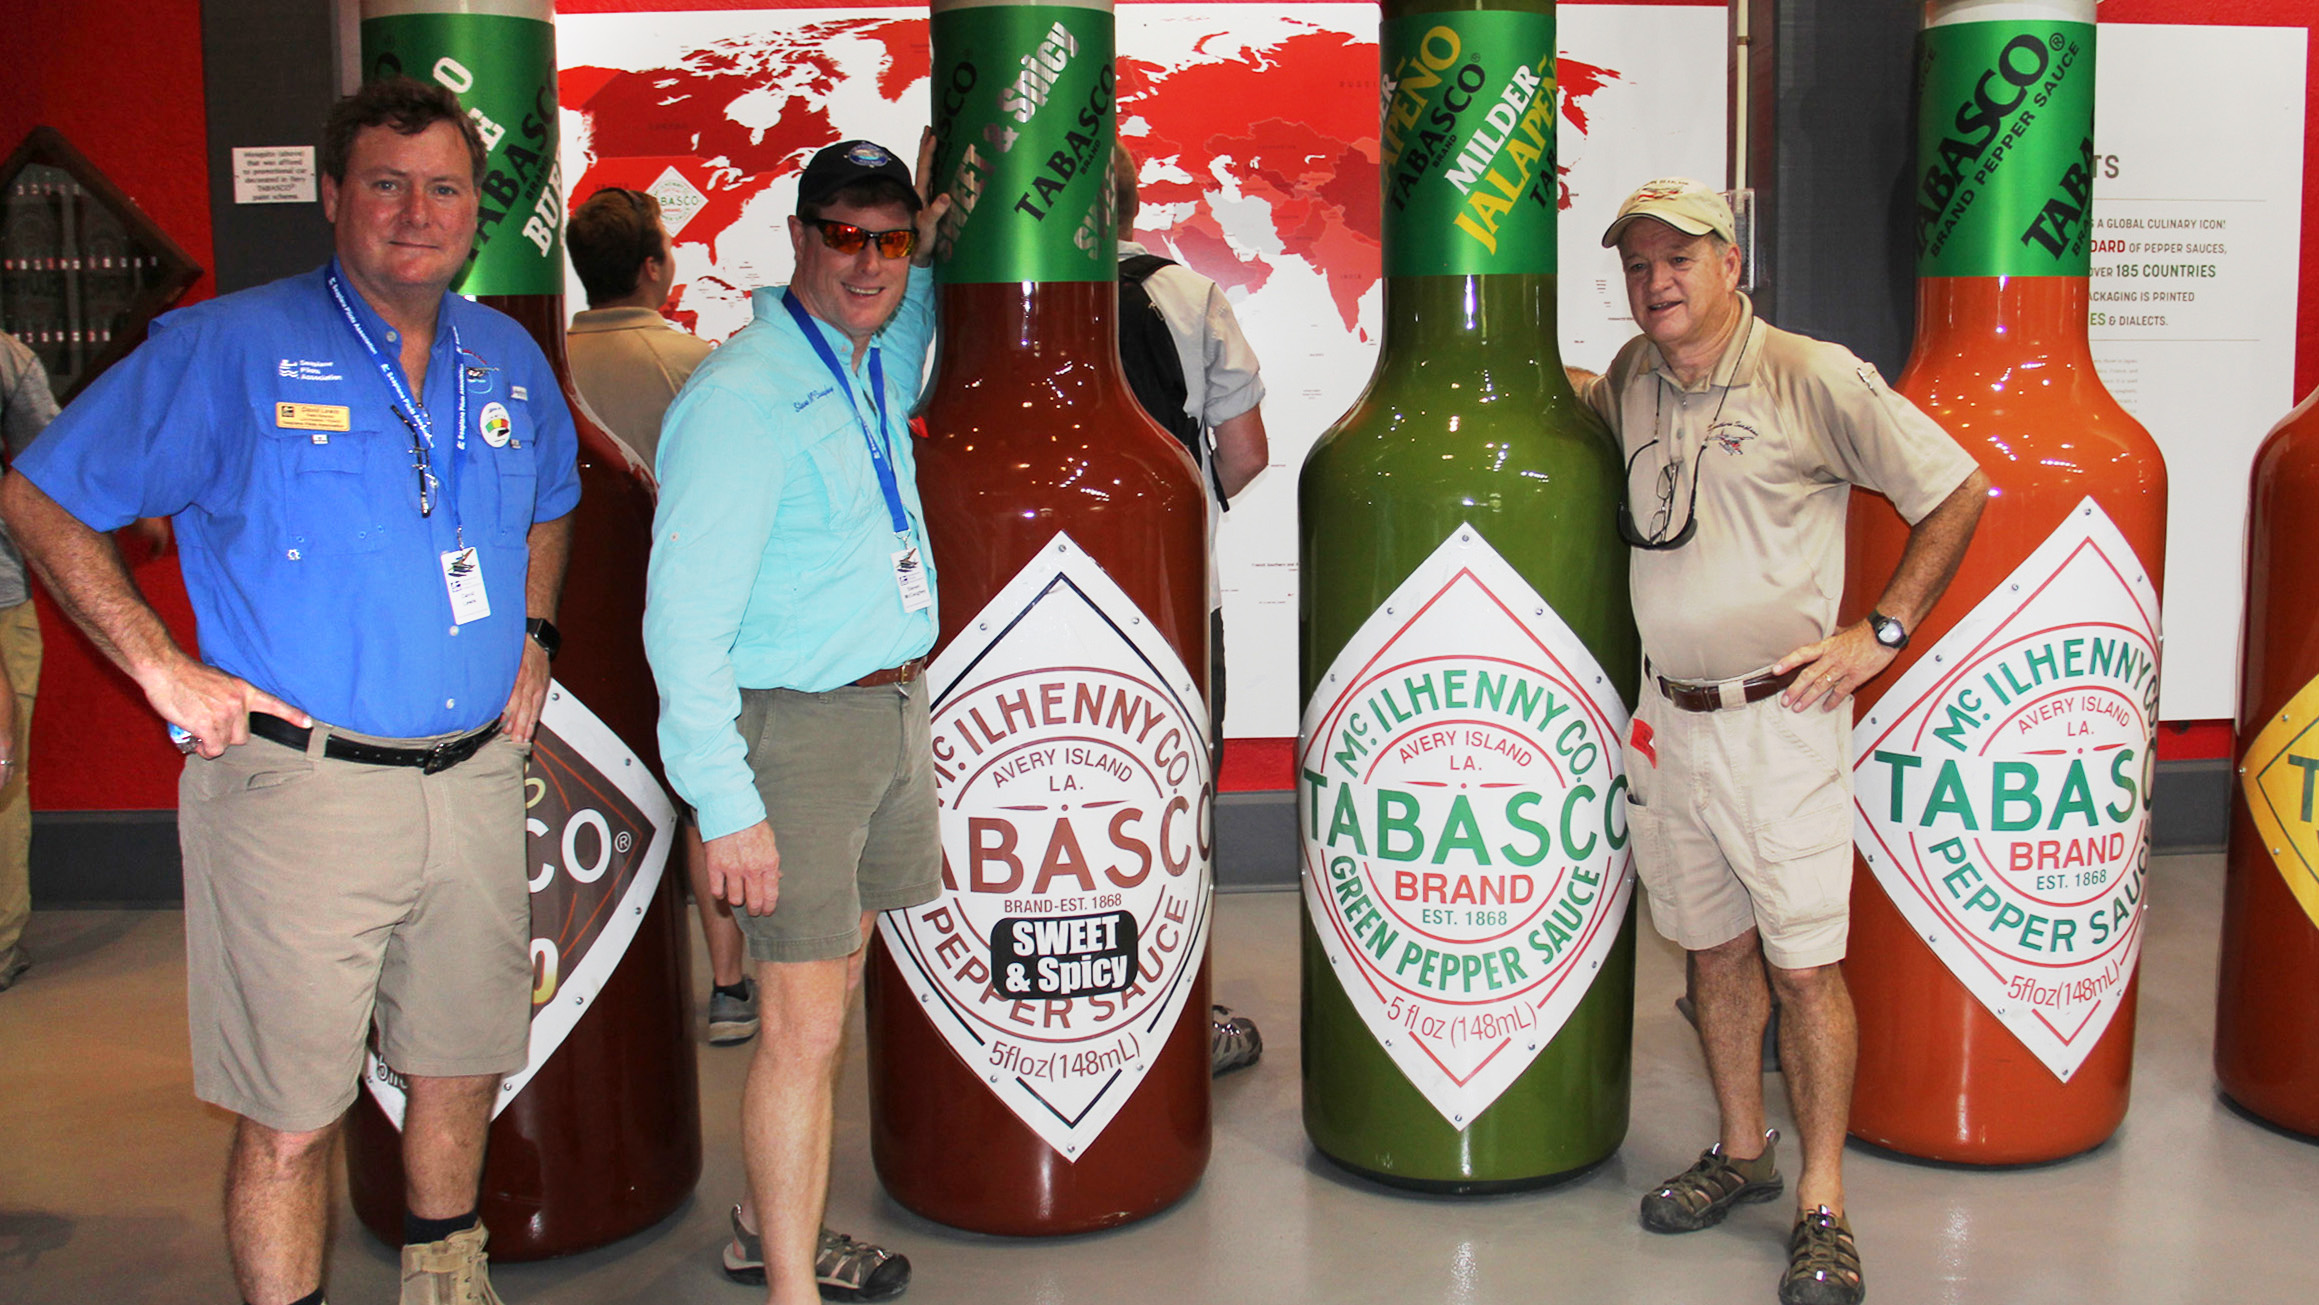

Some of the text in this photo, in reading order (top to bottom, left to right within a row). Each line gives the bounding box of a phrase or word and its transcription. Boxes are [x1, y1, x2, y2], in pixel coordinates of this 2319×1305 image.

[983, 123, 1020, 153] &
[1014, 64, 1115, 222] TABASCO
[1444, 64, 1541, 196] MILDER
[1931, 41, 2080, 257] BRAND PEPPER SAUCE
[1432, 134, 1458, 169] BRAND
[2097, 218, 2104, 228] A
[2106, 218, 2145, 229] GLOBAL
[2147, 219, 2197, 229] CULINARY
[2200, 219, 2226, 230] ICON!
[2129, 243, 2142, 253] OF
[2144, 243, 2183, 254] PEPPER
[2185, 243, 2227, 255] SAUCES,
[2116, 264, 2139, 278] 185
[2142, 264, 2217, 278] COUNTRIES
[2140, 292, 2150, 302] IS
[2152, 292, 2195, 302] PRINTED
[2108, 315, 2116, 326] &
[2119, 315, 2169, 326] DIALECTS.
[1983, 637, 2152, 706] ILHENNY
[1368, 669, 1570, 733] ILHENNY
[1556, 719, 1597, 783] CO.
[2018, 696, 2131, 735] AVERY ISLAND
[2067, 721, 2095, 737] LA.
[954, 682, 1166, 756] ILHENNY
[1154, 728, 1190, 794] CO.
[1400, 730, 1532, 767] AVERY ISLAND
[993, 748, 1133, 788] AVERY ISLAND
[1450, 755, 1482, 771] LA.
[1049, 775, 1083, 791] LA.
[1303, 767, 1628, 867] TABASCO
[527, 808, 632, 893] CO®
[2009, 832, 2125, 871] BRAND
[1395, 870, 1534, 905] BRAND
[1928, 836, 2077, 953] PEPPER
[2036, 869, 2107, 890] EST. 1868
[1092, 893, 1122, 909] 1868
[1422, 909, 1508, 926] EST. 1868
[1012, 914, 1120, 956] SWEET
[1330, 855, 1600, 993] GREEN PEPPER SAUCE
[1005, 954, 1128, 995] & Spicy
[1387, 996, 1404, 1021] 5
[1421, 1017, 1447, 1041] oz
[1450, 1001, 1537, 1048] (148mL)
